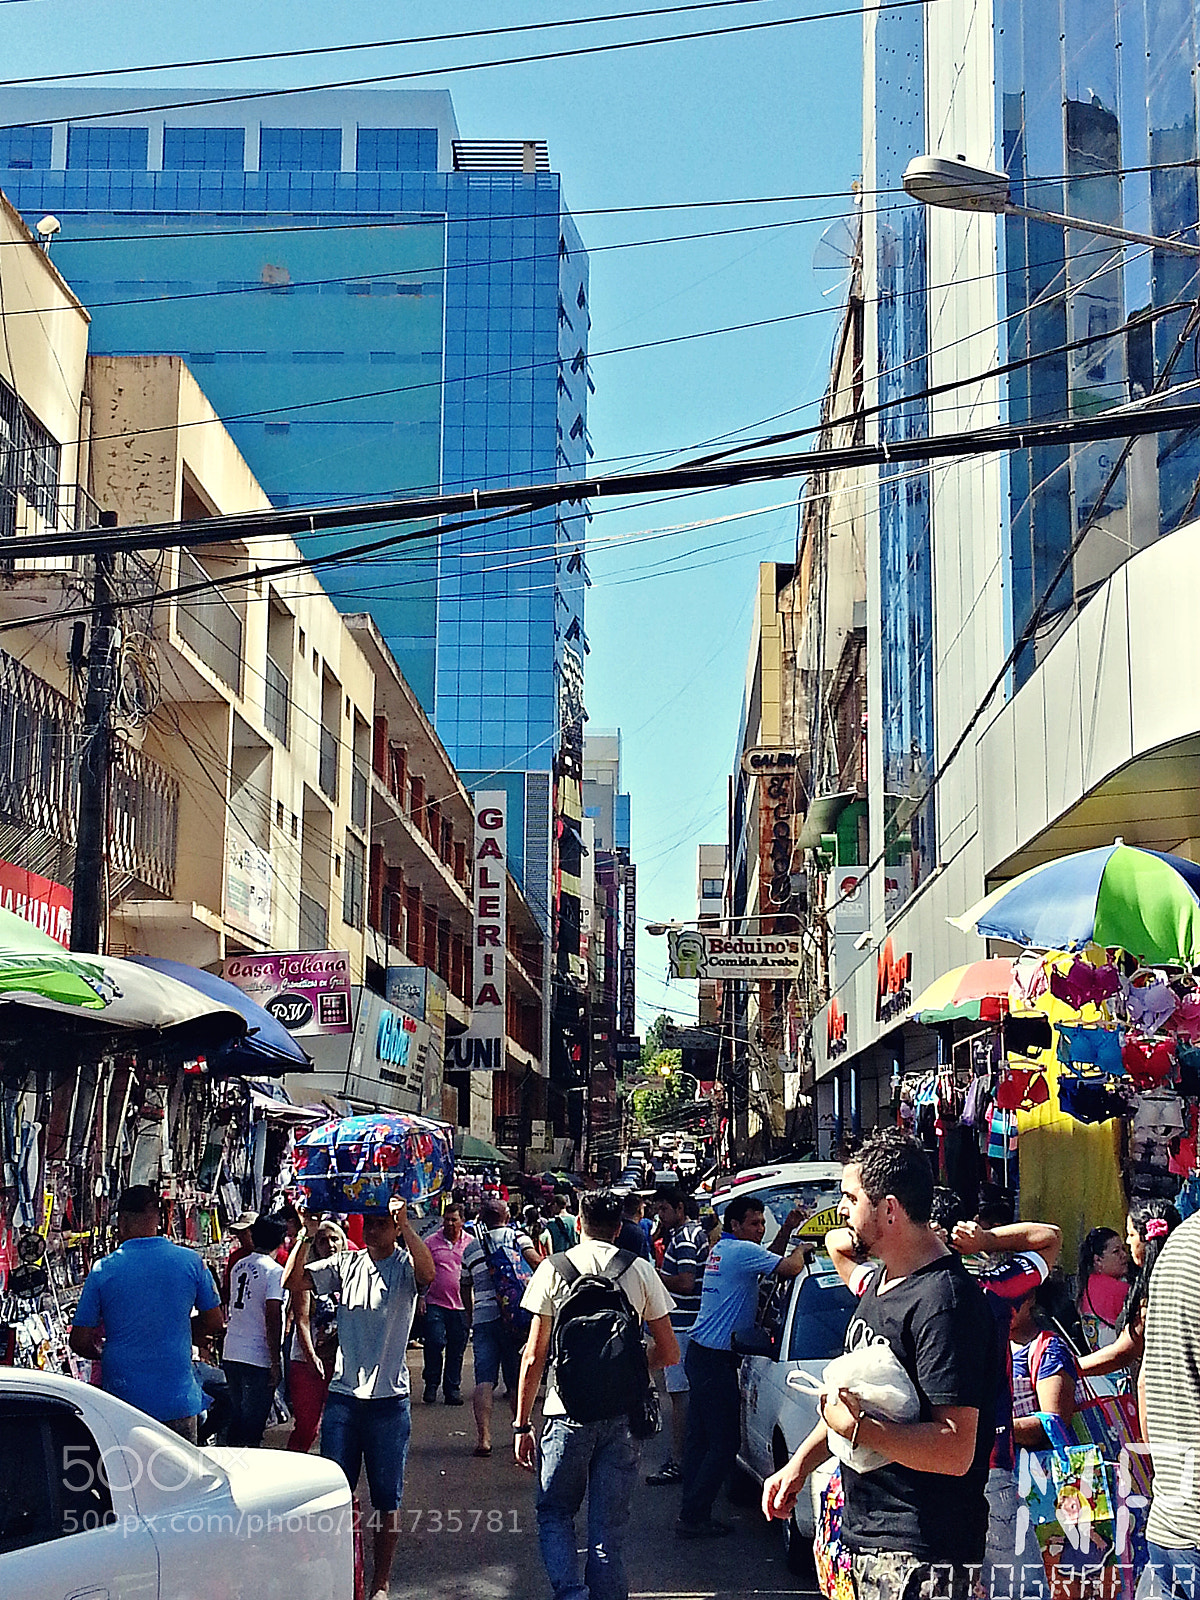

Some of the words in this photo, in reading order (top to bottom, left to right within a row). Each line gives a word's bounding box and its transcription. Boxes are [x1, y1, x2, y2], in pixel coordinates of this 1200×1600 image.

[476, 808, 504, 1006] GALERIA
[708, 938, 799, 954] Beduino's
[228, 961, 275, 979] Casa
[279, 956, 346, 978] Johana
[708, 956, 758, 967] Comida
[762, 957, 799, 967] Arabe
[817, 1208, 844, 1226] RAD
